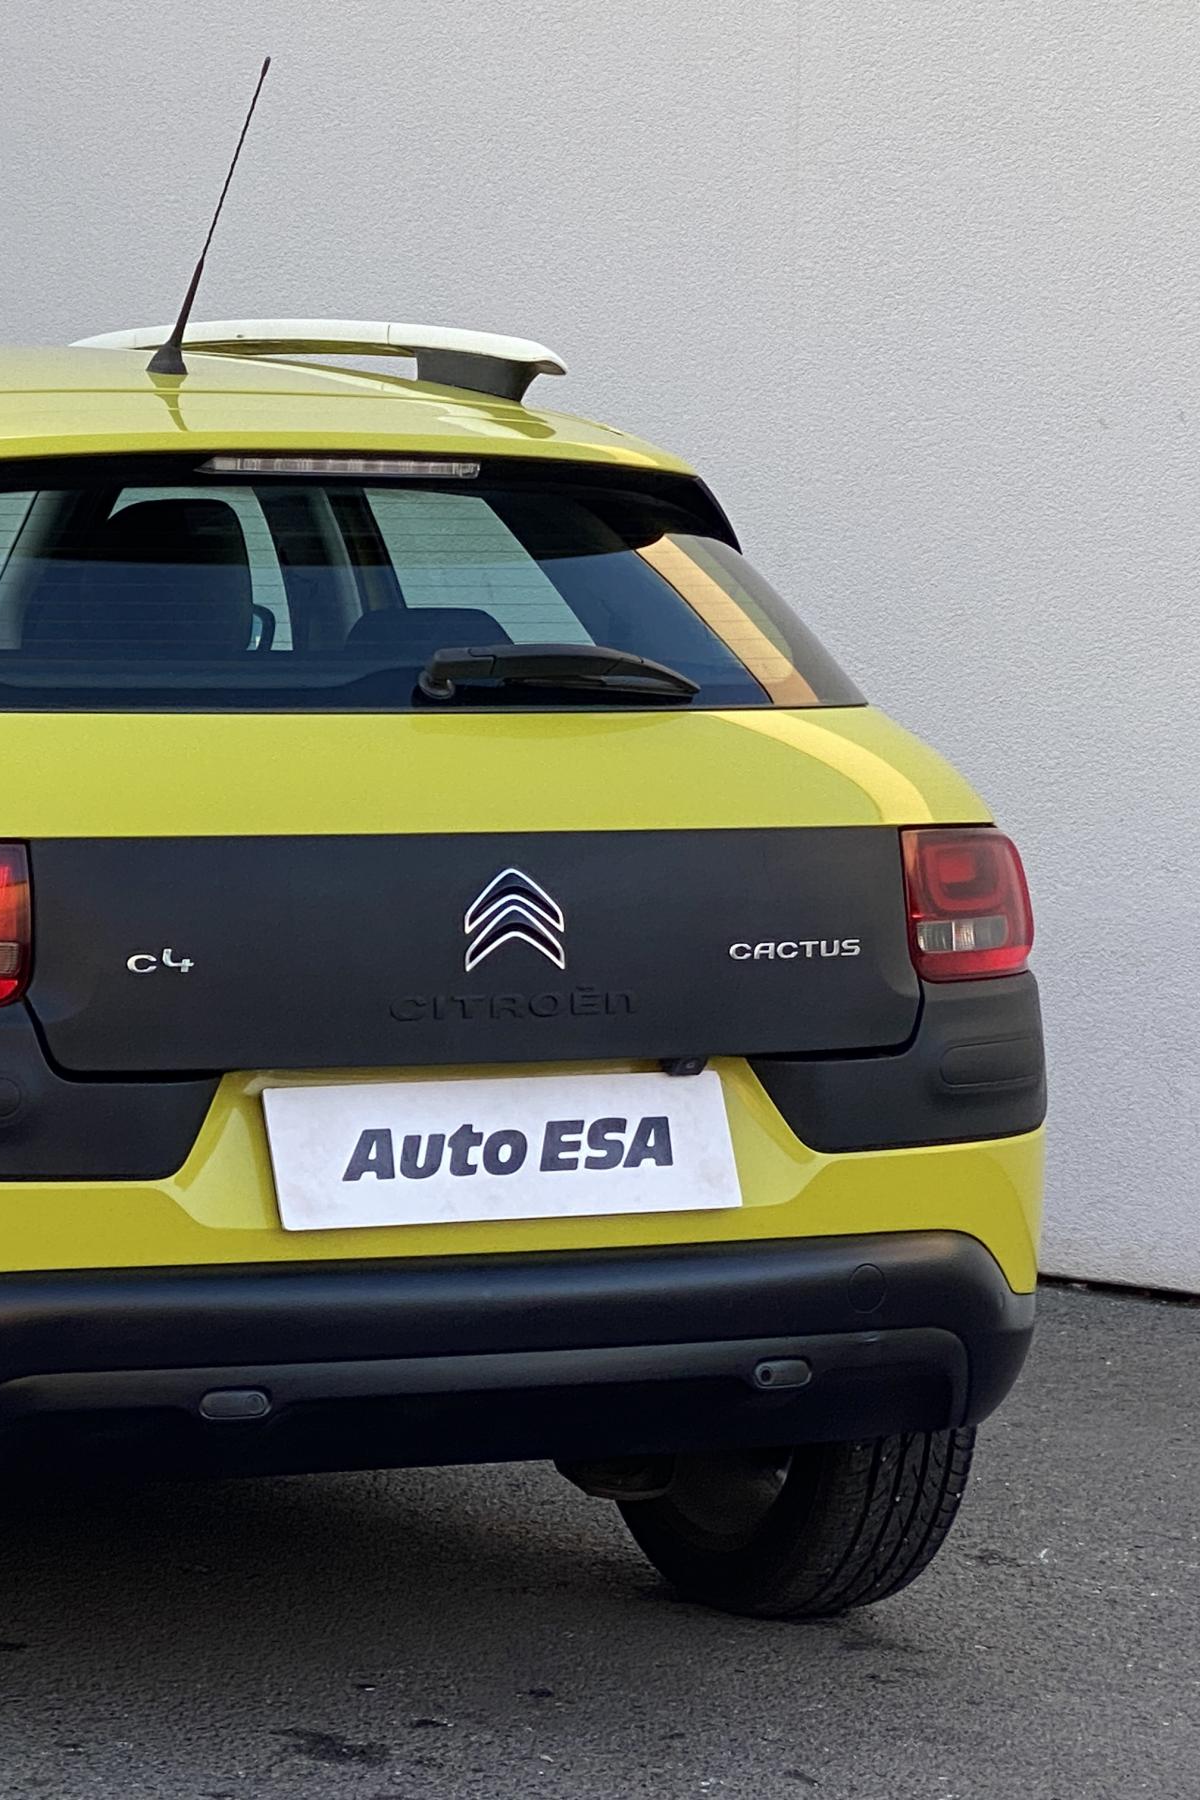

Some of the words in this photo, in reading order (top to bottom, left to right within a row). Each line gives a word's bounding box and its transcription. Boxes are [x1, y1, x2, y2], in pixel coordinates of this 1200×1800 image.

[127, 948, 195, 973] C4
[729, 939, 860, 961] CACTUS
[342, 1123, 528, 1181] Auto
[539, 1115, 674, 1172] ESA
